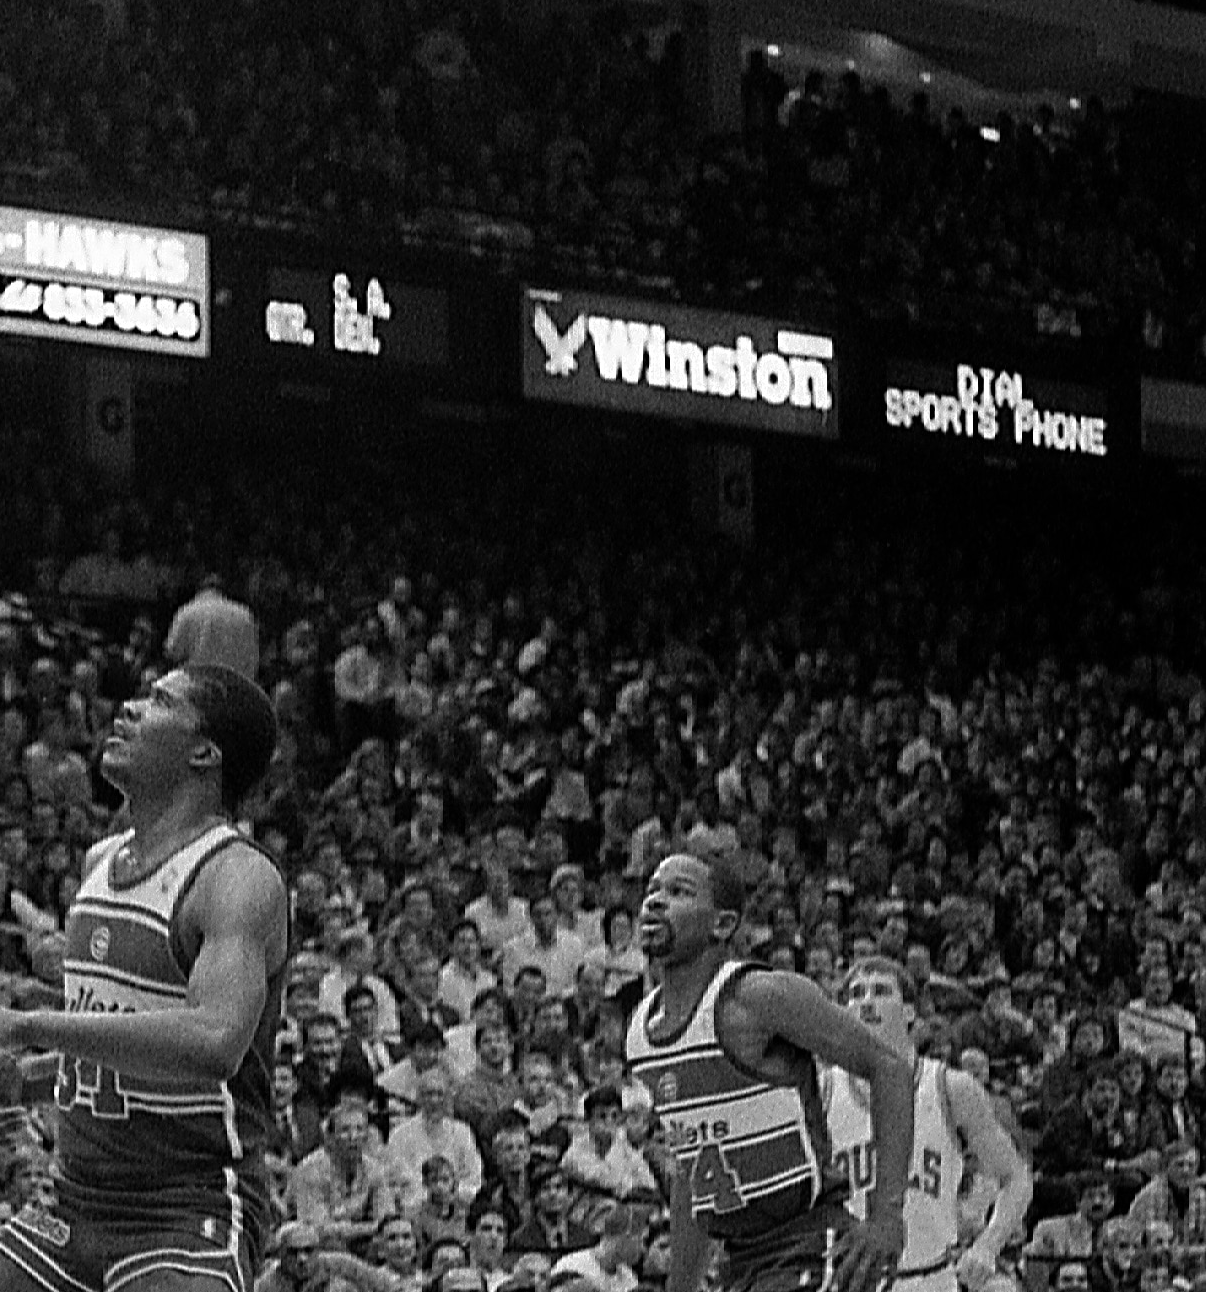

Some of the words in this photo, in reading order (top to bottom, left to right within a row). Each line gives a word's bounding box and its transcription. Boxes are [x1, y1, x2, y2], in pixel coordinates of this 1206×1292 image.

[587, 314, 833, 411] Winston
[885, 387, 999, 439] SPORTS
[1014, 398, 1107, 456] PHONE
